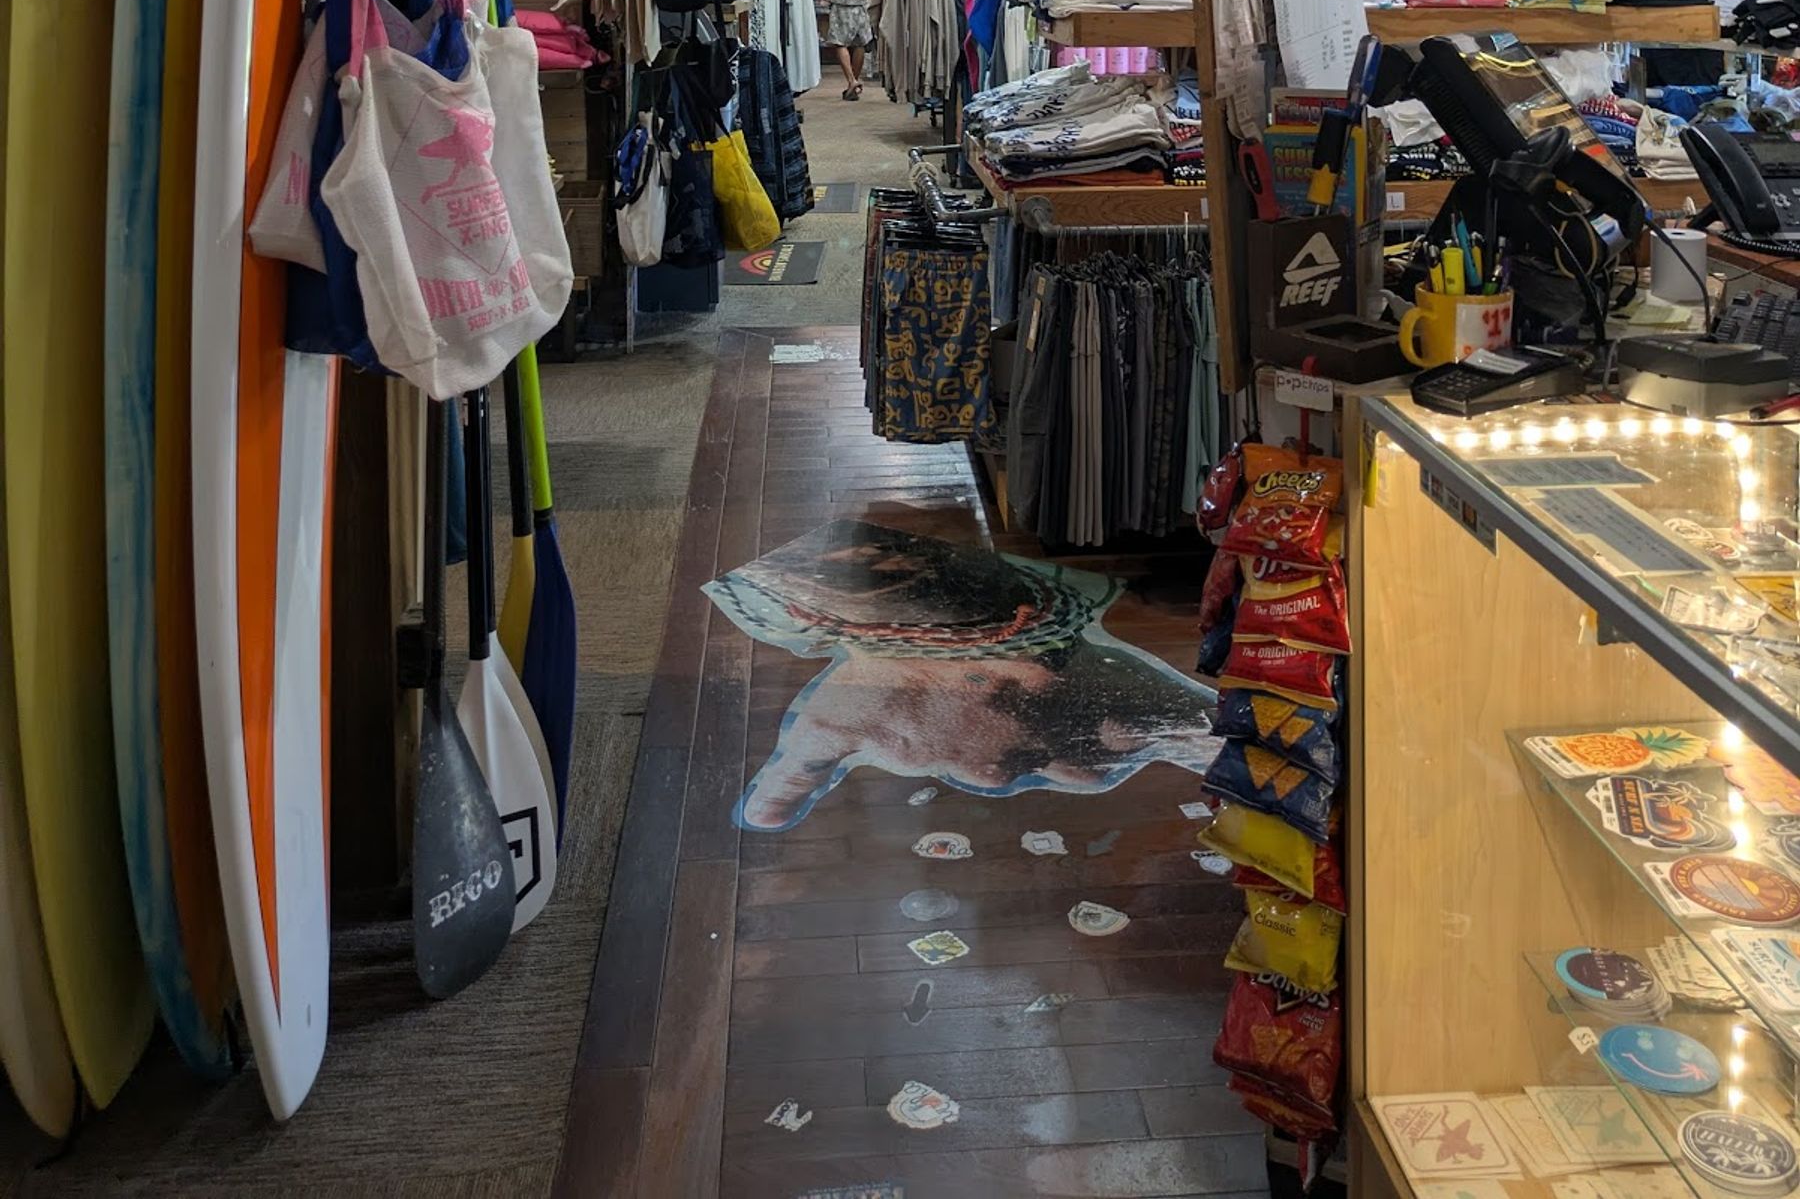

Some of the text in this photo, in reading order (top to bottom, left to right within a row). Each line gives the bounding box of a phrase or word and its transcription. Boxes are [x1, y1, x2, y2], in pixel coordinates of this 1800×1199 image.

[1280, 275, 1342, 308] REEF
[1269, 595, 1321, 616] ORIGINAL
[1254, 911, 1297, 938] Classic
